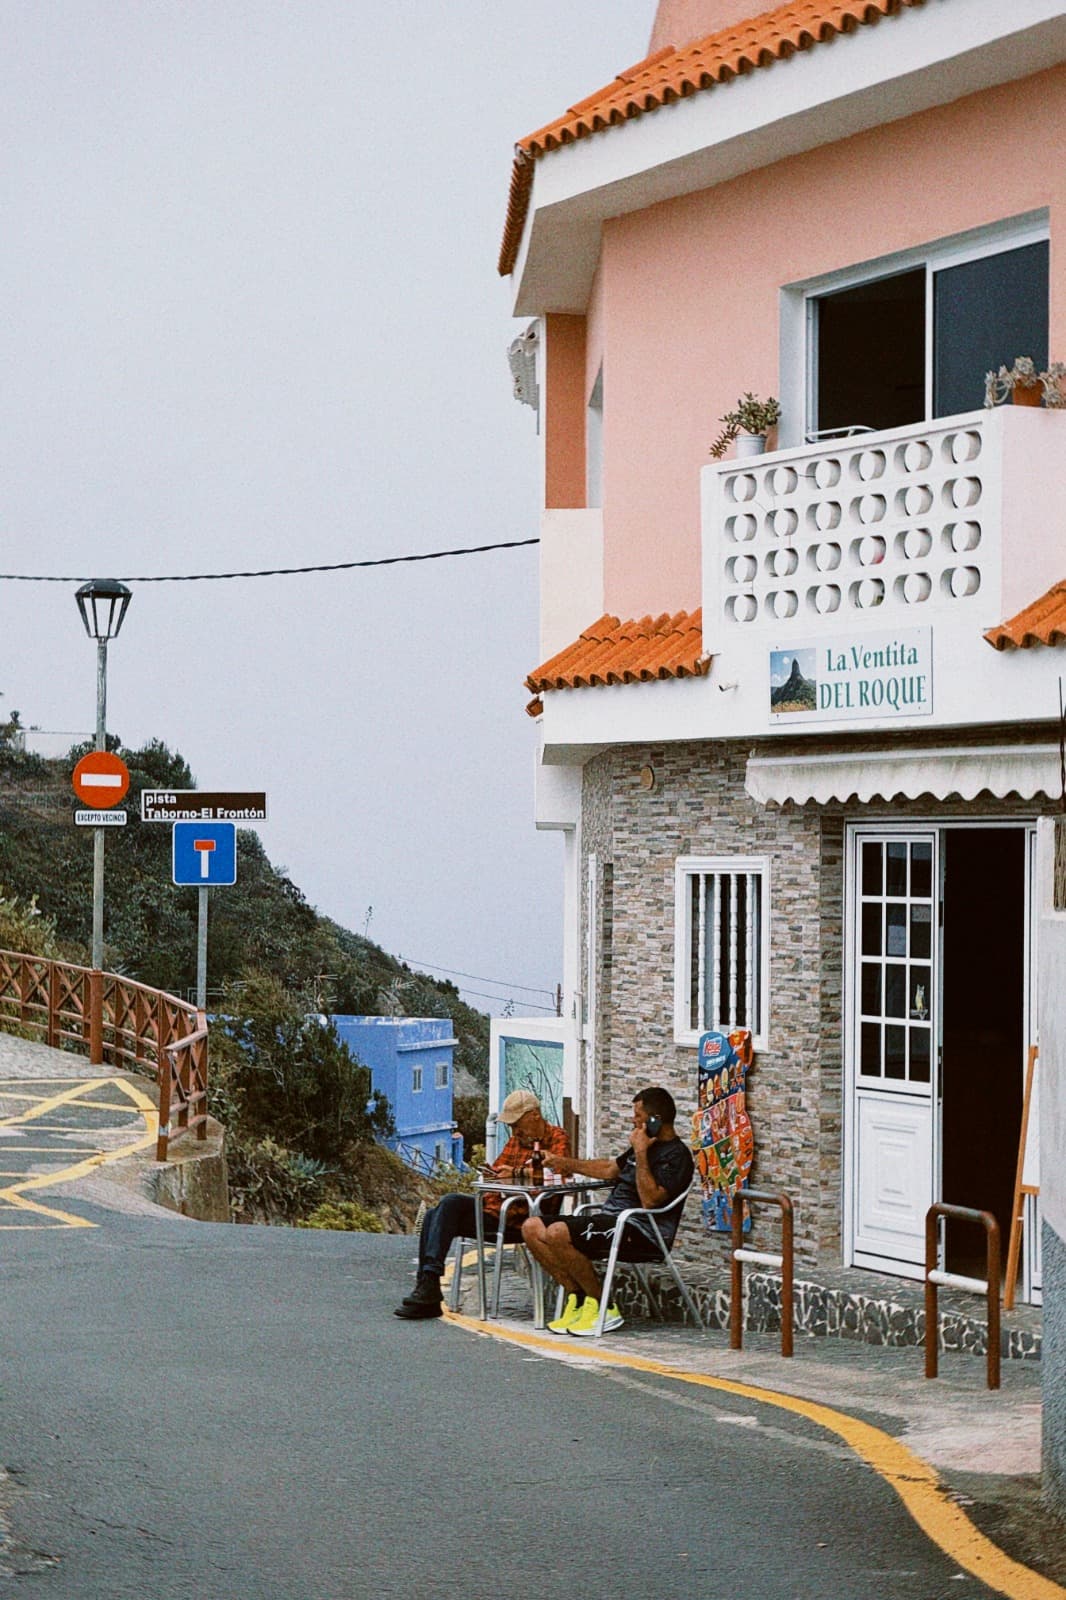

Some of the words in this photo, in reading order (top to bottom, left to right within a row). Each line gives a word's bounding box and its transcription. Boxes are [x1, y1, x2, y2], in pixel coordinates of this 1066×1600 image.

[827, 649, 847, 672] La
[850, 640, 918, 670] Ventita
[820, 681, 855, 710] DEL
[858, 675, 927, 711] ROQUE
[145, 793, 177, 806] pista
[77, 813, 102, 822] EXCEPTO
[102, 813, 125, 822] VECINOS
[216, 807, 265, 819] Frontón
